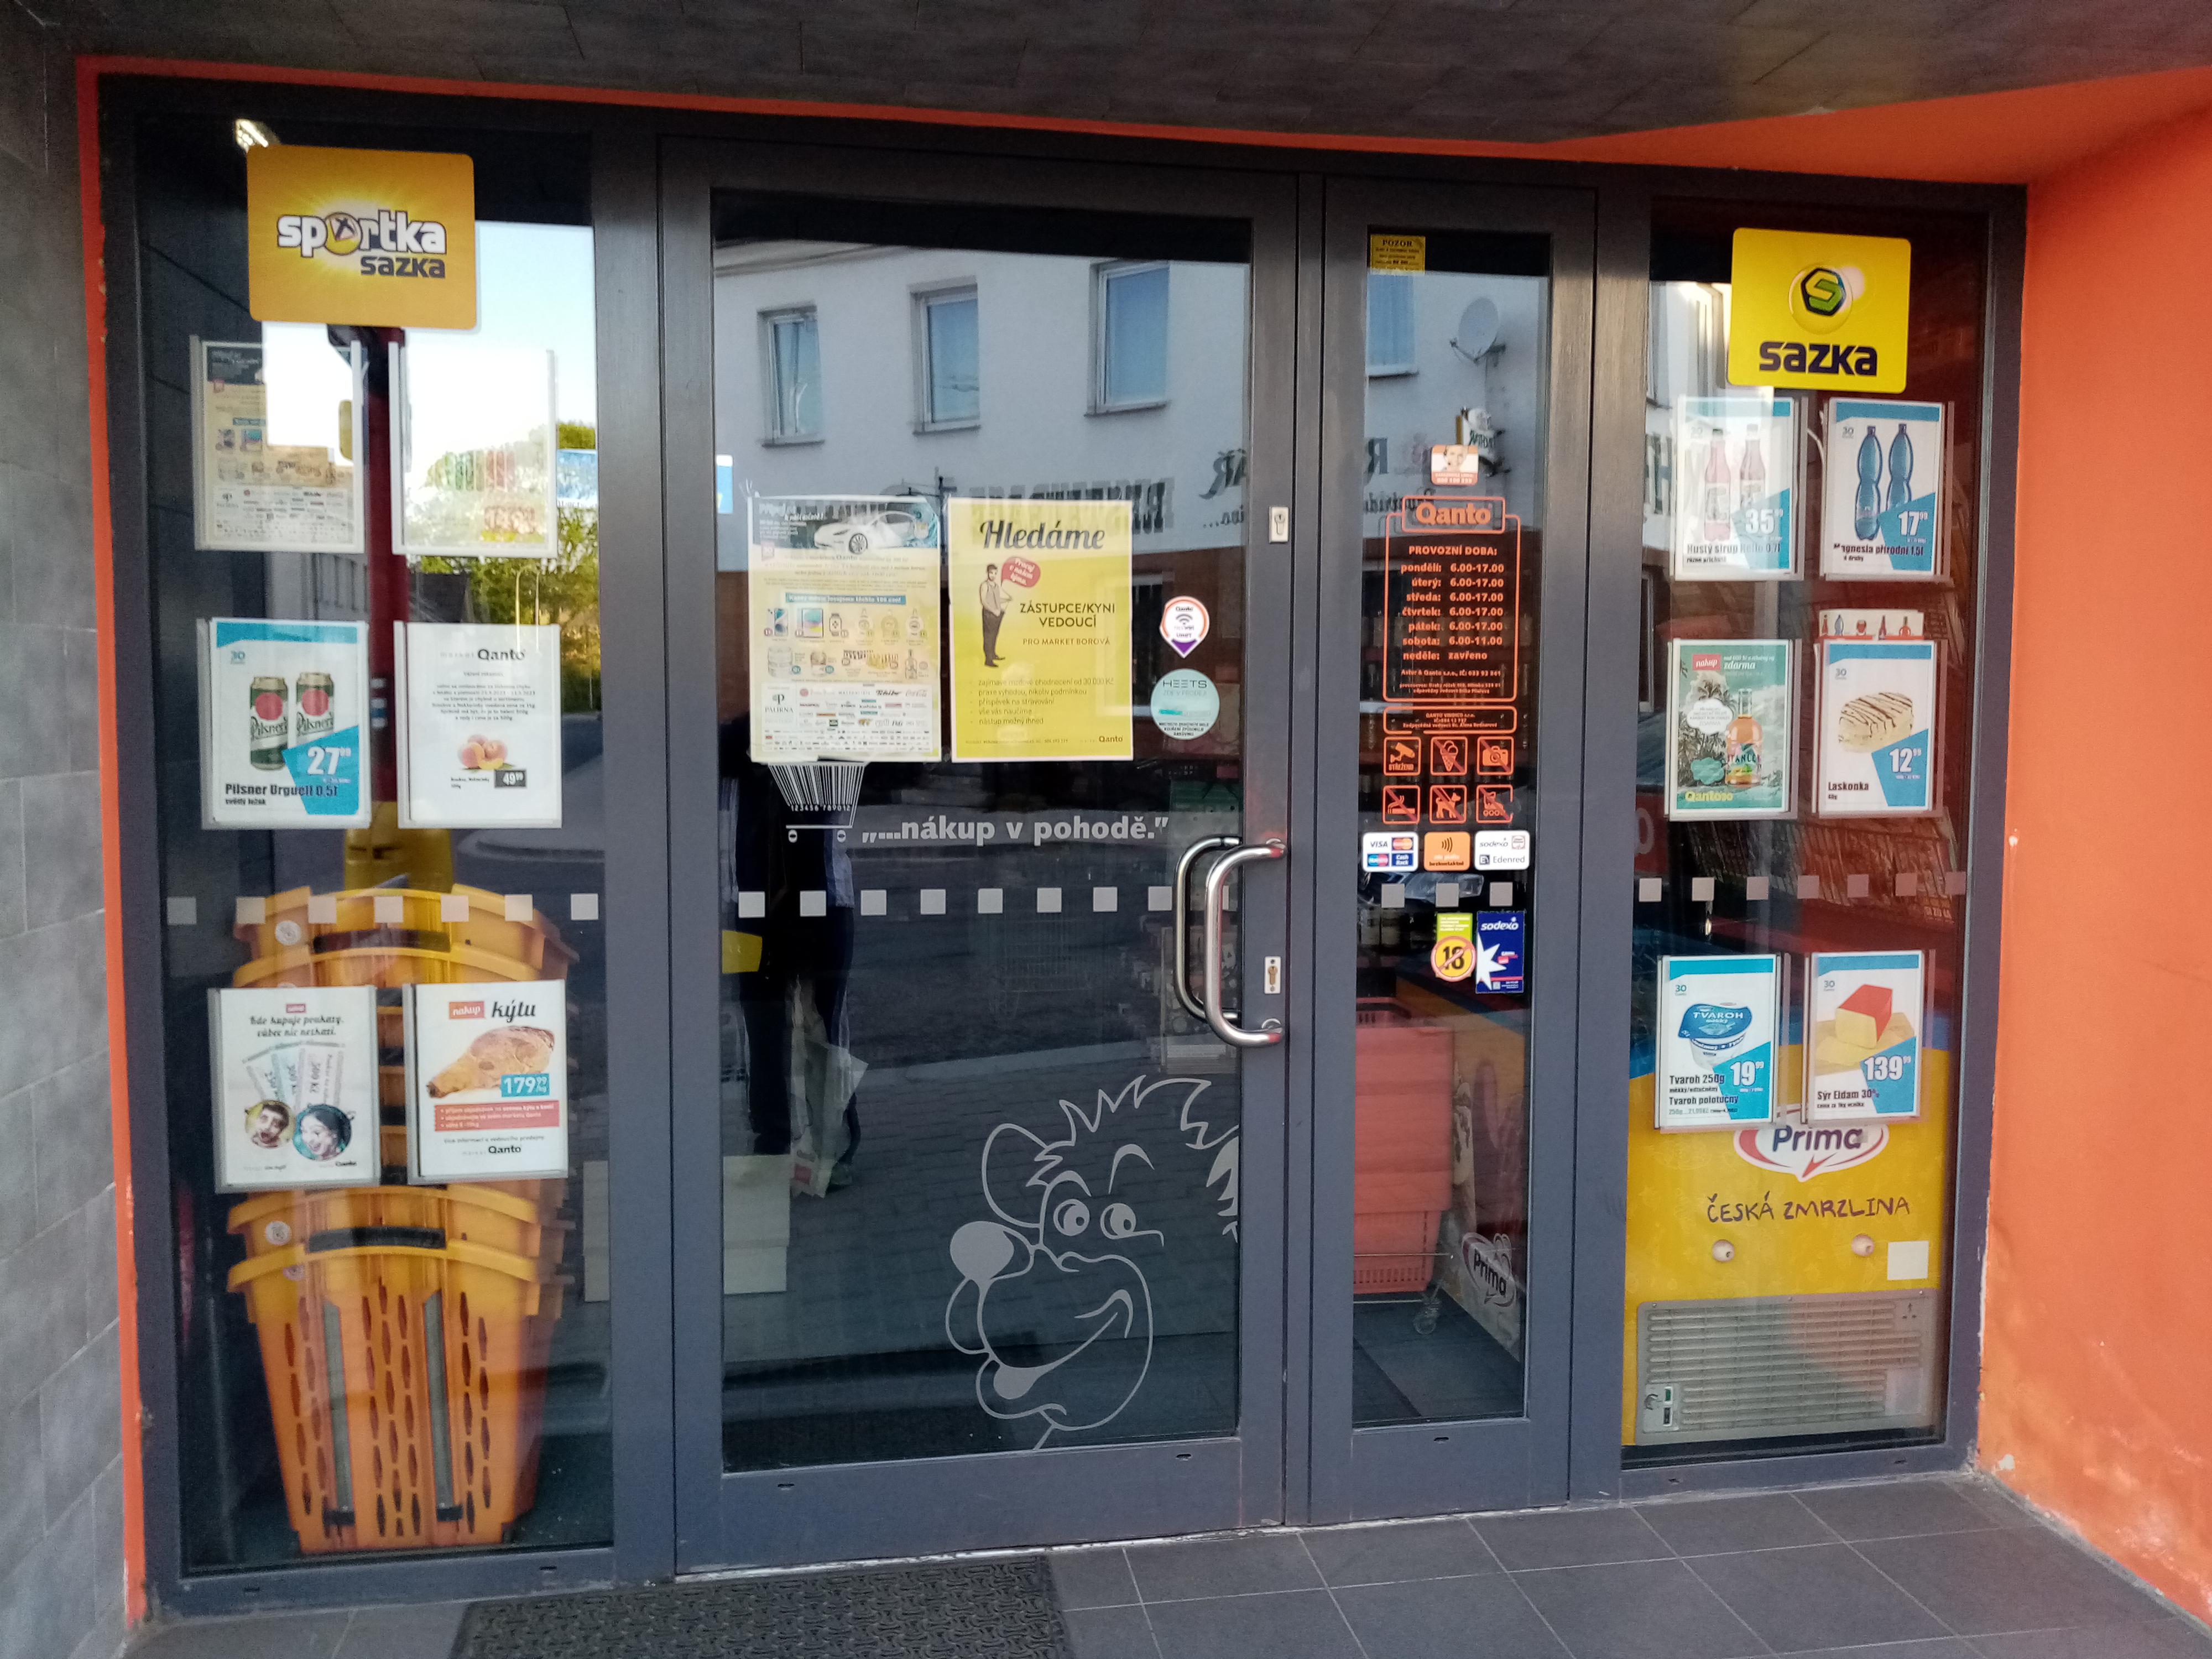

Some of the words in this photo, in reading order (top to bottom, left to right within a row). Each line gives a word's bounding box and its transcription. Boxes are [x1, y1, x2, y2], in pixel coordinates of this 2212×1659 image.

[277, 210, 447, 258] sportka
[361, 255, 446, 279] sazka
[1759, 341, 1877, 377] sazka
[1415, 502, 1492, 525] Qanto
[1745, 508, 1775, 535] 35
[1897, 510, 1920, 536] 17
[980, 520, 1105, 550] Hledáme
[1408, 544, 1462, 556] PROVOZNÍ
[1464, 545, 1498, 556] DOBA:
[1400, 562, 1442, 575] pondělí:
[1450, 562, 1505, 573] 6.00-17.00
[1411, 577, 1441, 589] úterý:
[1449, 577, 1504, 587] 6.00-17.00
[1406, 591, 1441, 602] středa:
[1449, 592, 1504, 602] 6.00-17.00
[1019, 599, 1115, 614] ZÁSTUPCE/KYNI
[1402, 606, 1441, 617] čtvrtek:
[1449, 607, 1504, 617] 6.00-17.00
[1039, 614, 1097, 628] VEDOUCÍ
[1408, 621, 1441, 633] pátek:
[1449, 621, 1503, 631] 6.00-17.00
[1078, 636, 1111, 645] BOROVÁ
[1402, 636, 1440, 646] sobota:
[1448, 636, 1503, 646] 6.00-11.00
[477, 648, 525, 661] Qanto
[1402, 650, 1440, 660] neděle:
[1448, 650, 1488, 660] zavřeno
[1723, 661, 1756, 670] zdarma
[1163, 680, 1207, 688] HEETS
[1051, 688, 1087, 696] podmínkou
[979, 718, 1002, 727] nástup
[1003, 717, 1024, 726] možný
[307, 746, 341, 775] 27
[1888, 748, 1913, 773] 12
[225, 783, 268, 795] Pilsner
[1828, 781, 1869, 791] Laskonka
[1006, 821, 1024, 839] v
[1370, 840, 1389, 848] VISA
[1479, 838, 1509, 848] sodexo
[1493, 855, 1526, 864] Edenred
[1480, 918, 1520, 931] sodexo
[1443, 946, 1465, 971] 18
[1675, 984, 1687, 992] 30
[1824, 980, 1835, 988] 30
[491, 999, 536, 1024] kýtu
[1730, 1061, 1756, 1087] 19
[1864, 1055, 1903, 1081] 139
[503, 1076, 535, 1095] 179
[1670, 1075, 1700, 1085] Tvaroh
[1702, 1074, 1725, 1084] 250g
[1669, 1097, 1697, 1105] Tvaroh
[488, 1145, 522, 1155] Qanto
[1707, 1191, 1774, 1223] ČESKÁ
[1783, 1195, 1911, 1220] ZMRZLINA
